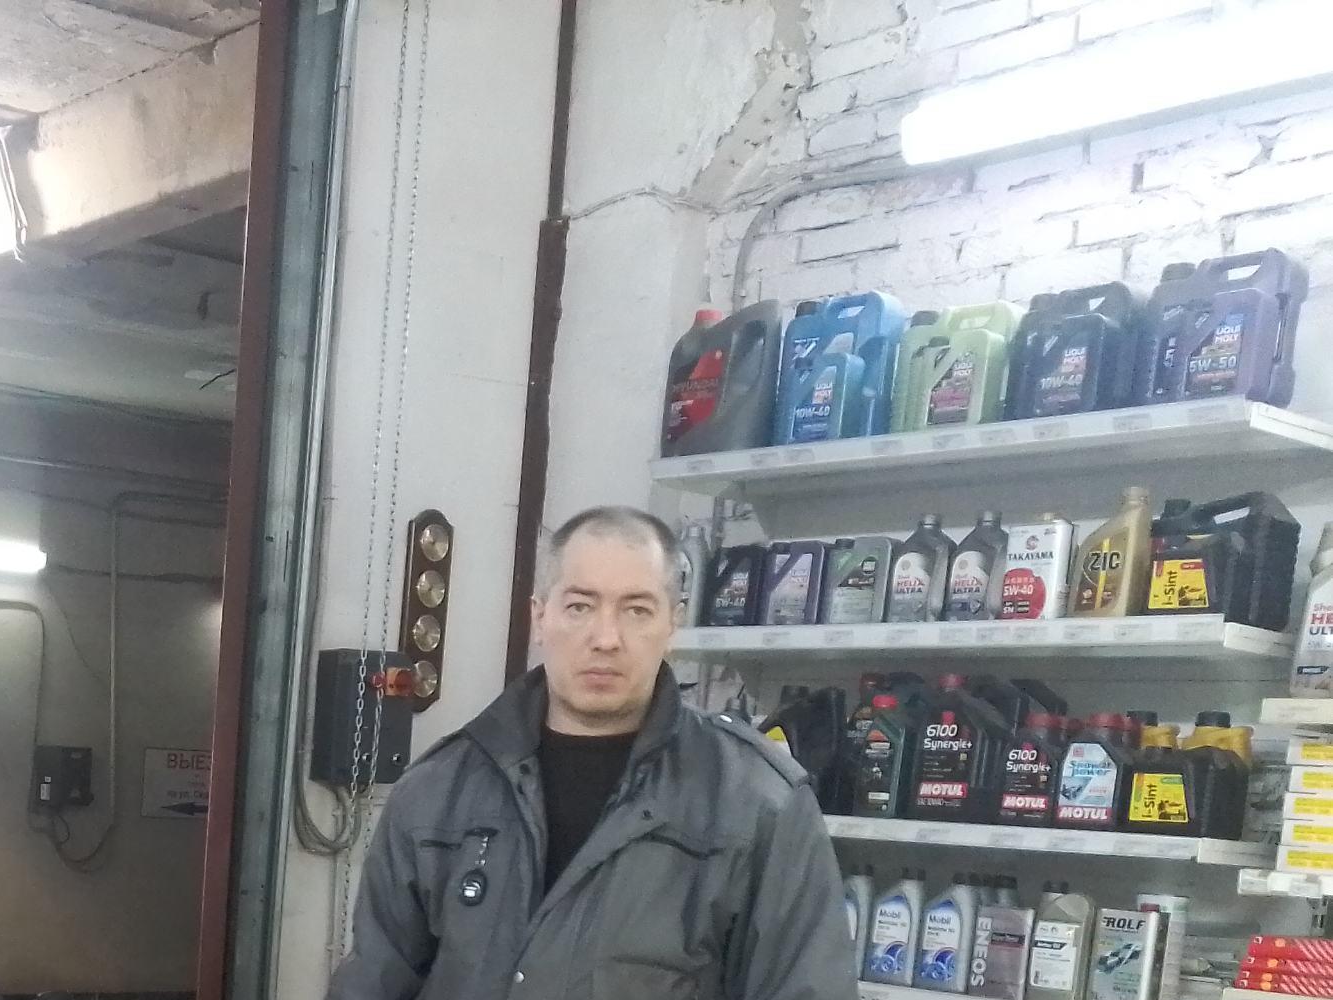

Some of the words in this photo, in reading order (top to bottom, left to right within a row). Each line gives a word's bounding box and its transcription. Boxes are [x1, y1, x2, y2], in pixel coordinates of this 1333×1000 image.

[1217, 325, 1241, 335] LIQUI
[1215, 333, 1239, 344] MOLY
[1189, 355, 1237, 374] 5W-50
[1008, 551, 1054, 561] TAKAYAMA
[1089, 551, 1121, 571] ZIC
[896, 577, 925, 587] HELIX
[953, 576, 983, 587] HELIX
[1003, 584, 1034, 596] 5W-40
[1311, 612, 1333, 625] HE
[1309, 625, 1333, 636] ULT
[926, 724, 959, 737] 6100
[923, 738, 973, 751] Synergie+
[1008, 749, 1038, 761] 6100
[167, 753, 213, 772] ВЫЕЗ
[1006, 761, 1052, 773] Synergie+
[920, 783, 964, 797] MOTUL
[1003, 796, 1046, 809] MOTUL
[1058, 807, 1108, 820] MOTUL
[879, 908, 901, 919] Mobil
[929, 914, 952, 925] Mobil
[1104, 916, 1146, 931] ROLF
[971, 917, 992, 987] ENEOS
